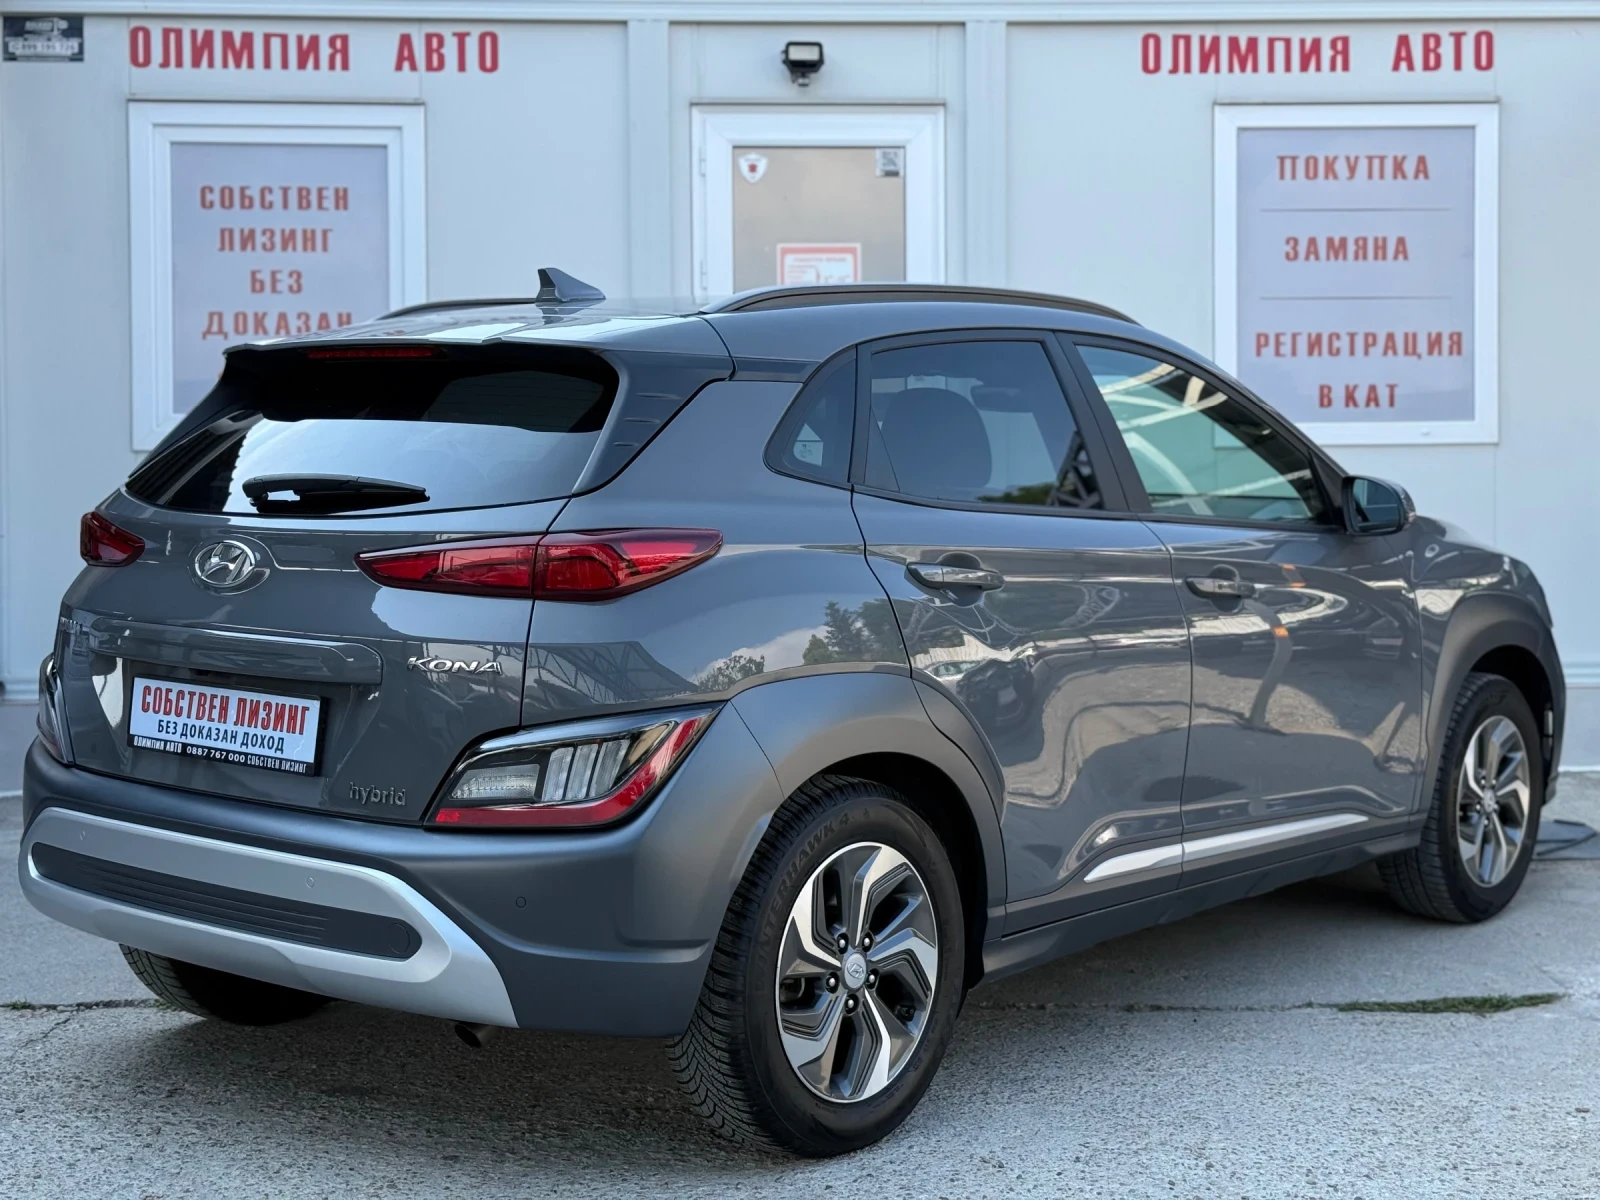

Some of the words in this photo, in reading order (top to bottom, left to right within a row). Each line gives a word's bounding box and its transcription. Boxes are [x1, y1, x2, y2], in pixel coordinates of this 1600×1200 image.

[129, 26, 350, 71] ОЛИМПИЯ
[395, 30, 500, 73] АВТО
[1141, 33, 1350, 74] ОЛИМПИЯ
[1392, 30, 1495, 72] АВТО
[1277, 155, 1430, 180] ПОКУПКА
[200, 186, 349, 211] СОБСТВЕН
[218, 228, 333, 252] ЛИЗИНГ
[1284, 236, 1410, 261] ЗАМЯНА
[250, 270, 303, 294] БЕЗ
[1255, 332, 1463, 360] РЕГИСТРАЦИЯ
[1318, 384, 1334, 408] В
[1344, 384, 1399, 408] КАТ
[407, 656, 503, 675] KONA
[141, 685, 230, 724] СОБСТВЕН
[233, 697, 310, 735] ЛИЗИНГ
[157, 719, 178, 735] БЕЗ
[180, 723, 238, 745] ДОКАЗАН
[240, 731, 285, 755] ДОХОД
[133, 735, 165, 751] ОЛИМПИЯ
[166, 741, 183, 753] АВТО
[186, 746, 208, 757] 0887
[209, 749, 227, 760] 767
[228, 752, 246, 763] 000
[247, 754, 280, 769] СОБСТВЕН
[281, 760, 307, 773] ЛИЗИНГ
[350, 782, 406, 806] hybrid
